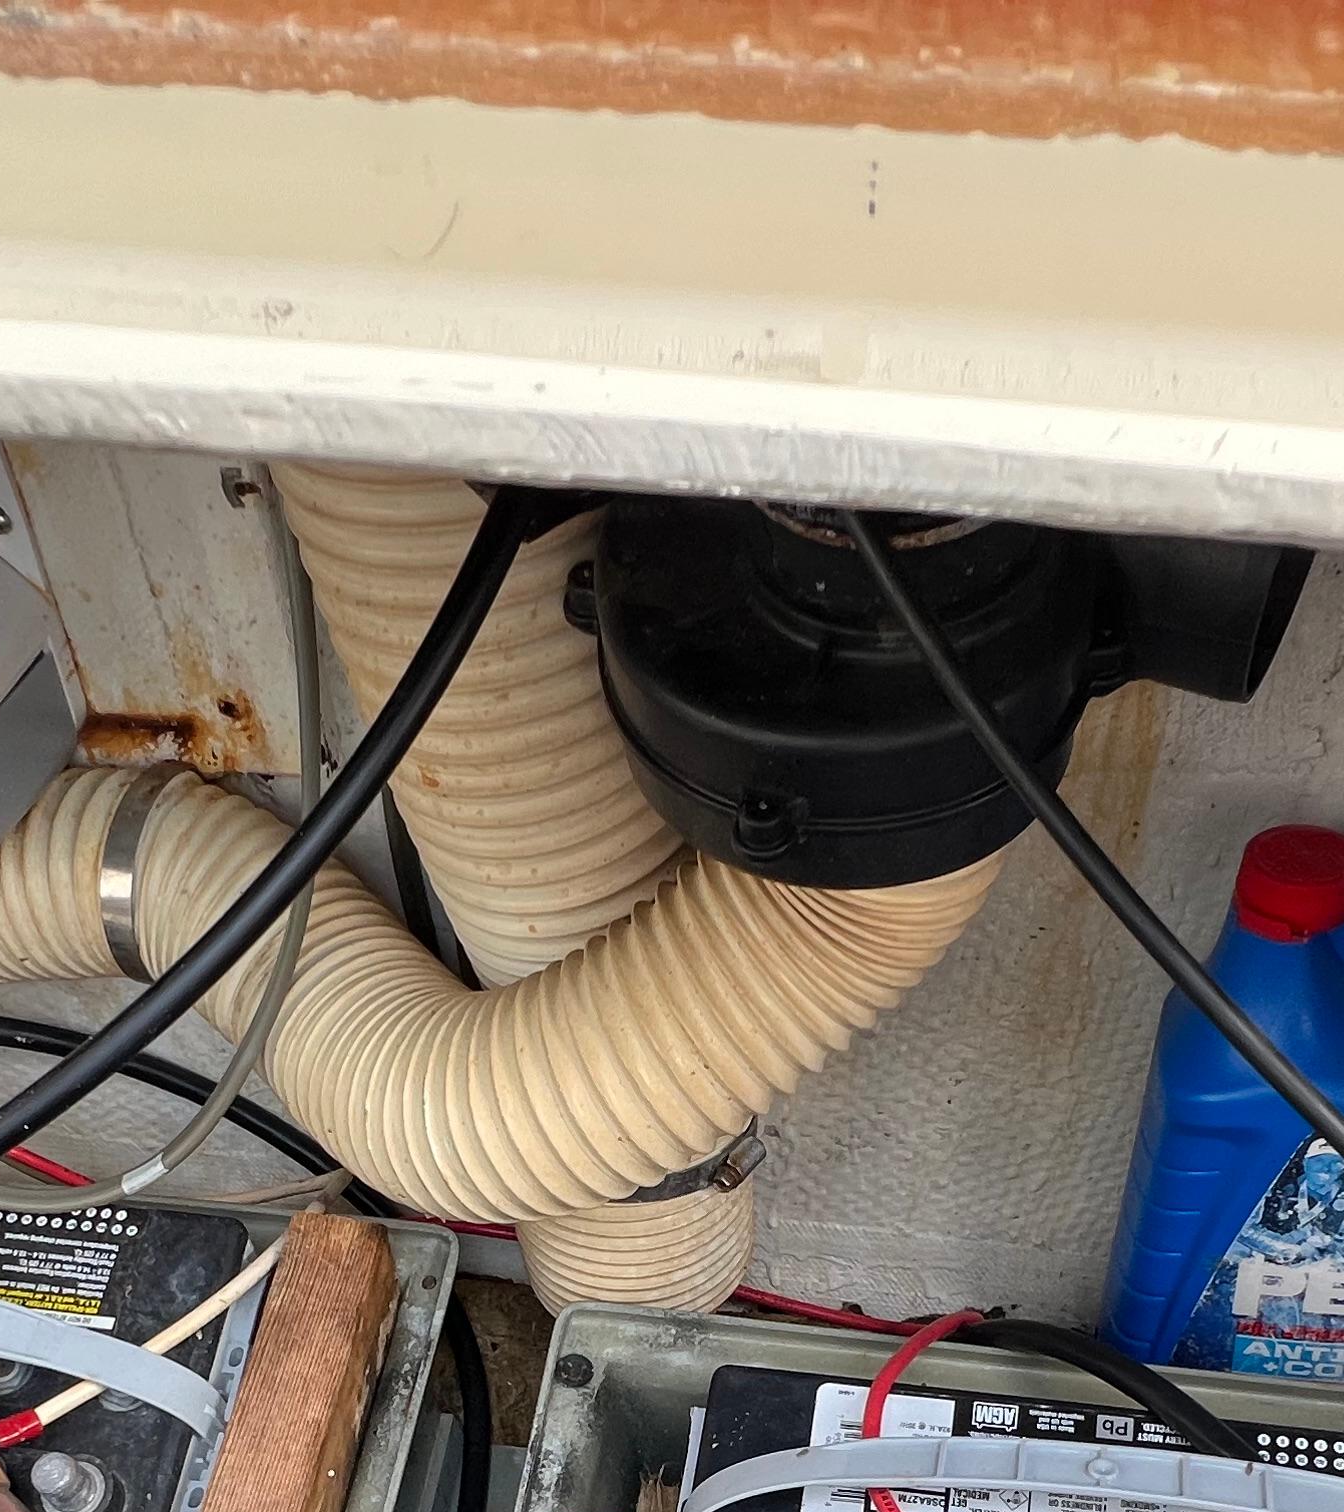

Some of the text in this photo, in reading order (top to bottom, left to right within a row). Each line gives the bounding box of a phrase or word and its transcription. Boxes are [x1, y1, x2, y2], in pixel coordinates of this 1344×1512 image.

[975, 1406, 1015, 1426] AGM
[1102, 1419, 1128, 1436] Pb
[1136, 1433, 1163, 1445] MUST
[952, 1489, 990, 1501] MEDICAL
[951, 1498, 967, 1507] GET
[1061, 1500, 1102, 1512] BLINDNESS
